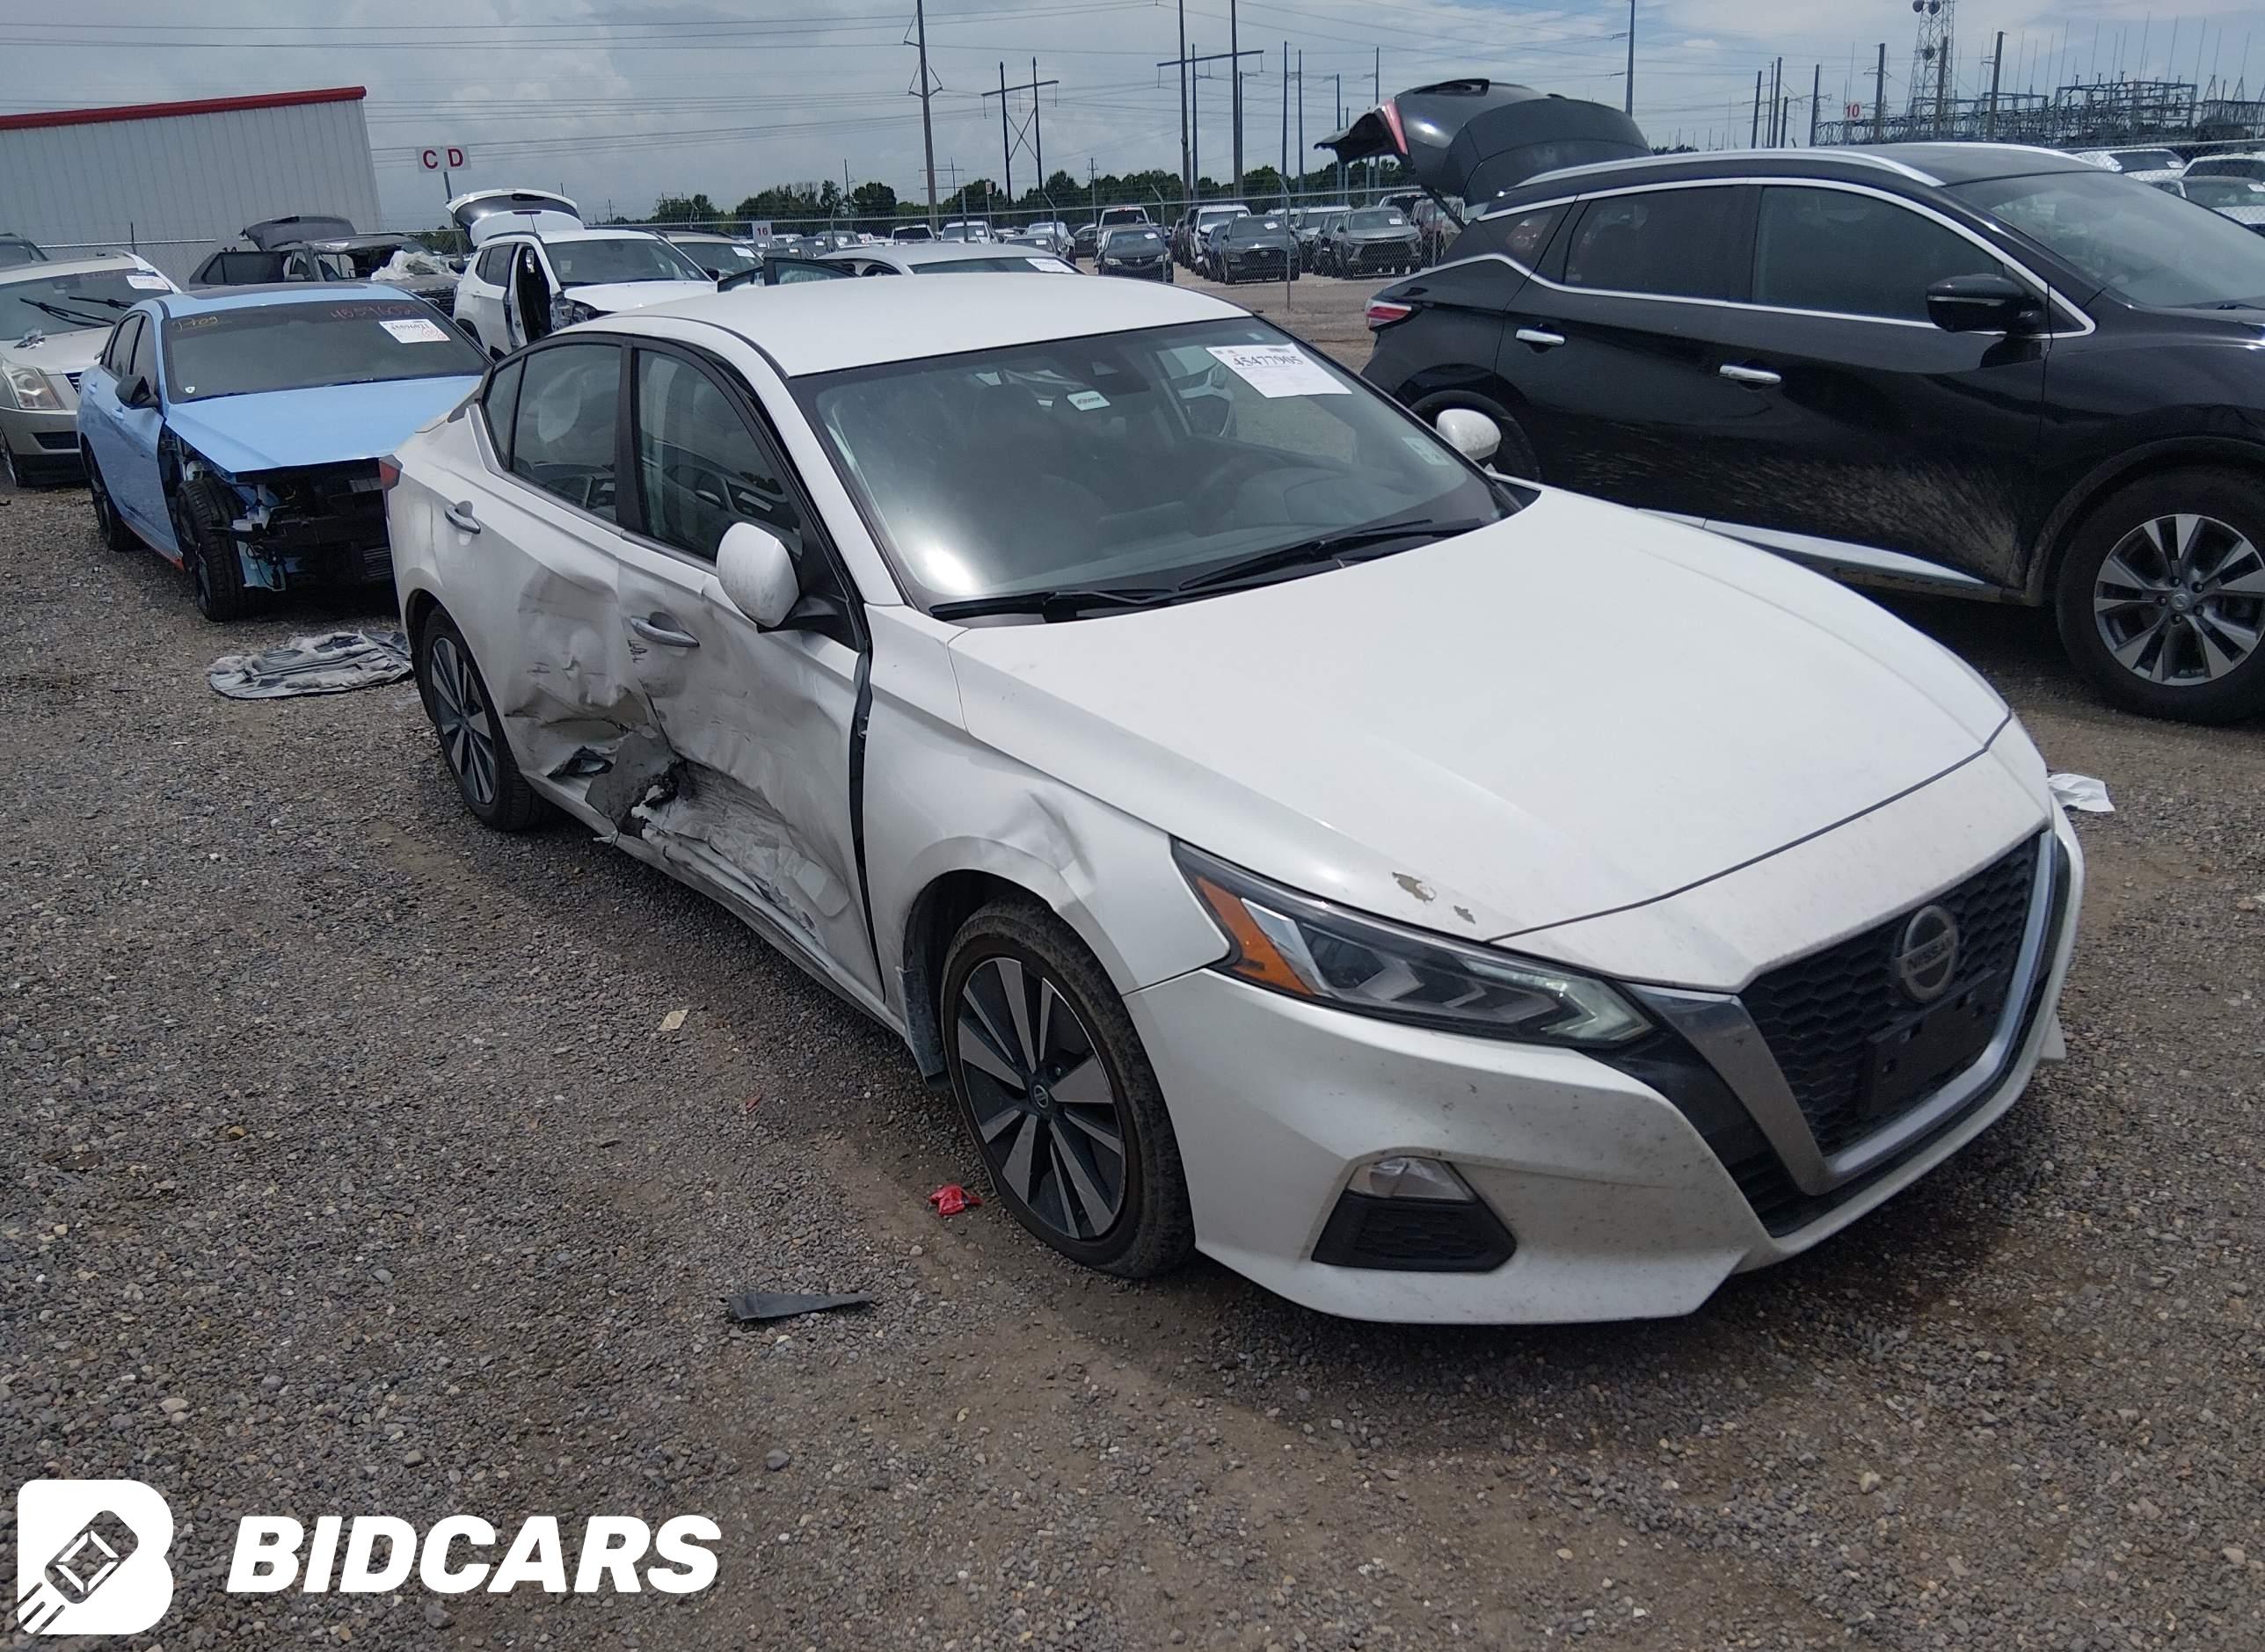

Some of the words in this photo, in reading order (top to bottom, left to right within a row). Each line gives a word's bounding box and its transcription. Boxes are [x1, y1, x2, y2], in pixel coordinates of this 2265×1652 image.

[1846, 104, 1860, 118] 10
[423, 149, 438, 169] C
[448, 148, 463, 167] D
